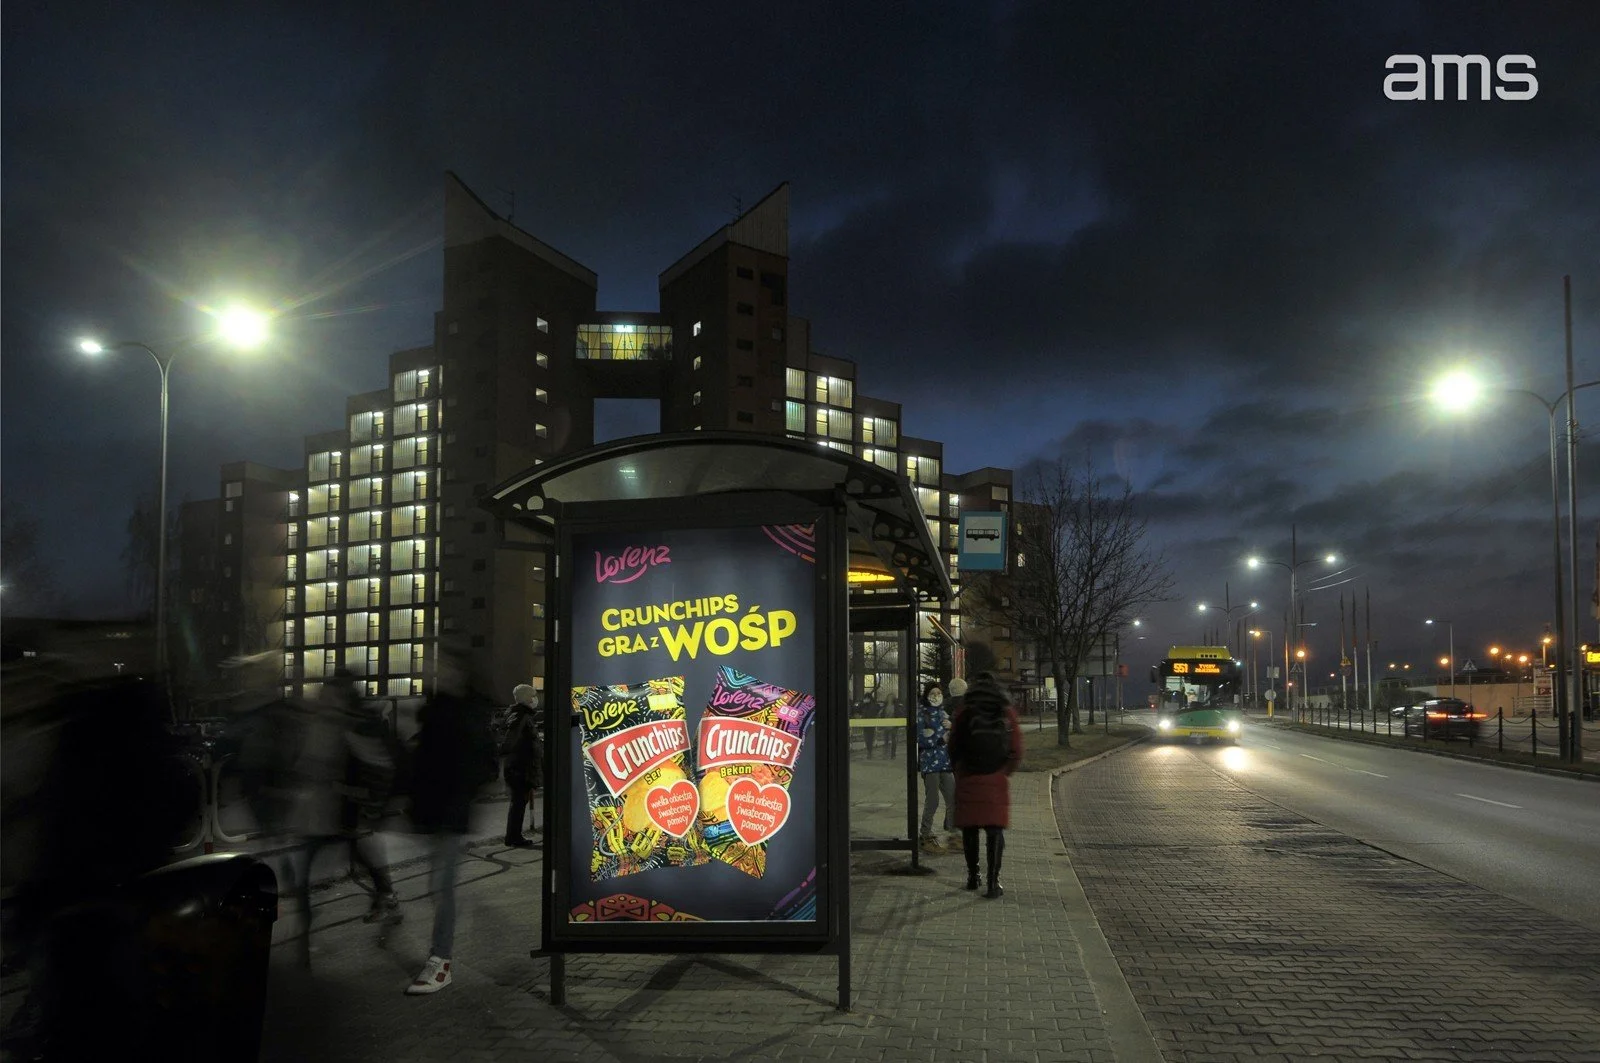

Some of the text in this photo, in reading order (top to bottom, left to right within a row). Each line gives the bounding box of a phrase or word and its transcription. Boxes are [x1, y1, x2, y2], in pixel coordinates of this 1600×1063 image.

[594, 545, 672, 584] Lorenz
[601, 594, 740, 632] CRUNCHIPS
[598, 633, 649, 658] GRA
[657, 605, 798, 662] WOŚP
[1173, 662, 1189, 674] 551
[713, 685, 765, 712] Lorenz
[582, 699, 639, 731] Lorenz
[605, 723, 685, 780] Crunchips
[705, 723, 793, 761] Crunchips
[644, 767, 662, 786] Ser
[650, 790, 693, 810] wielka orkiestra
[733, 791, 783, 812] wielka orkiestra
[667, 815, 689, 829] pomocy
[740, 820, 768, 837] pomocy
